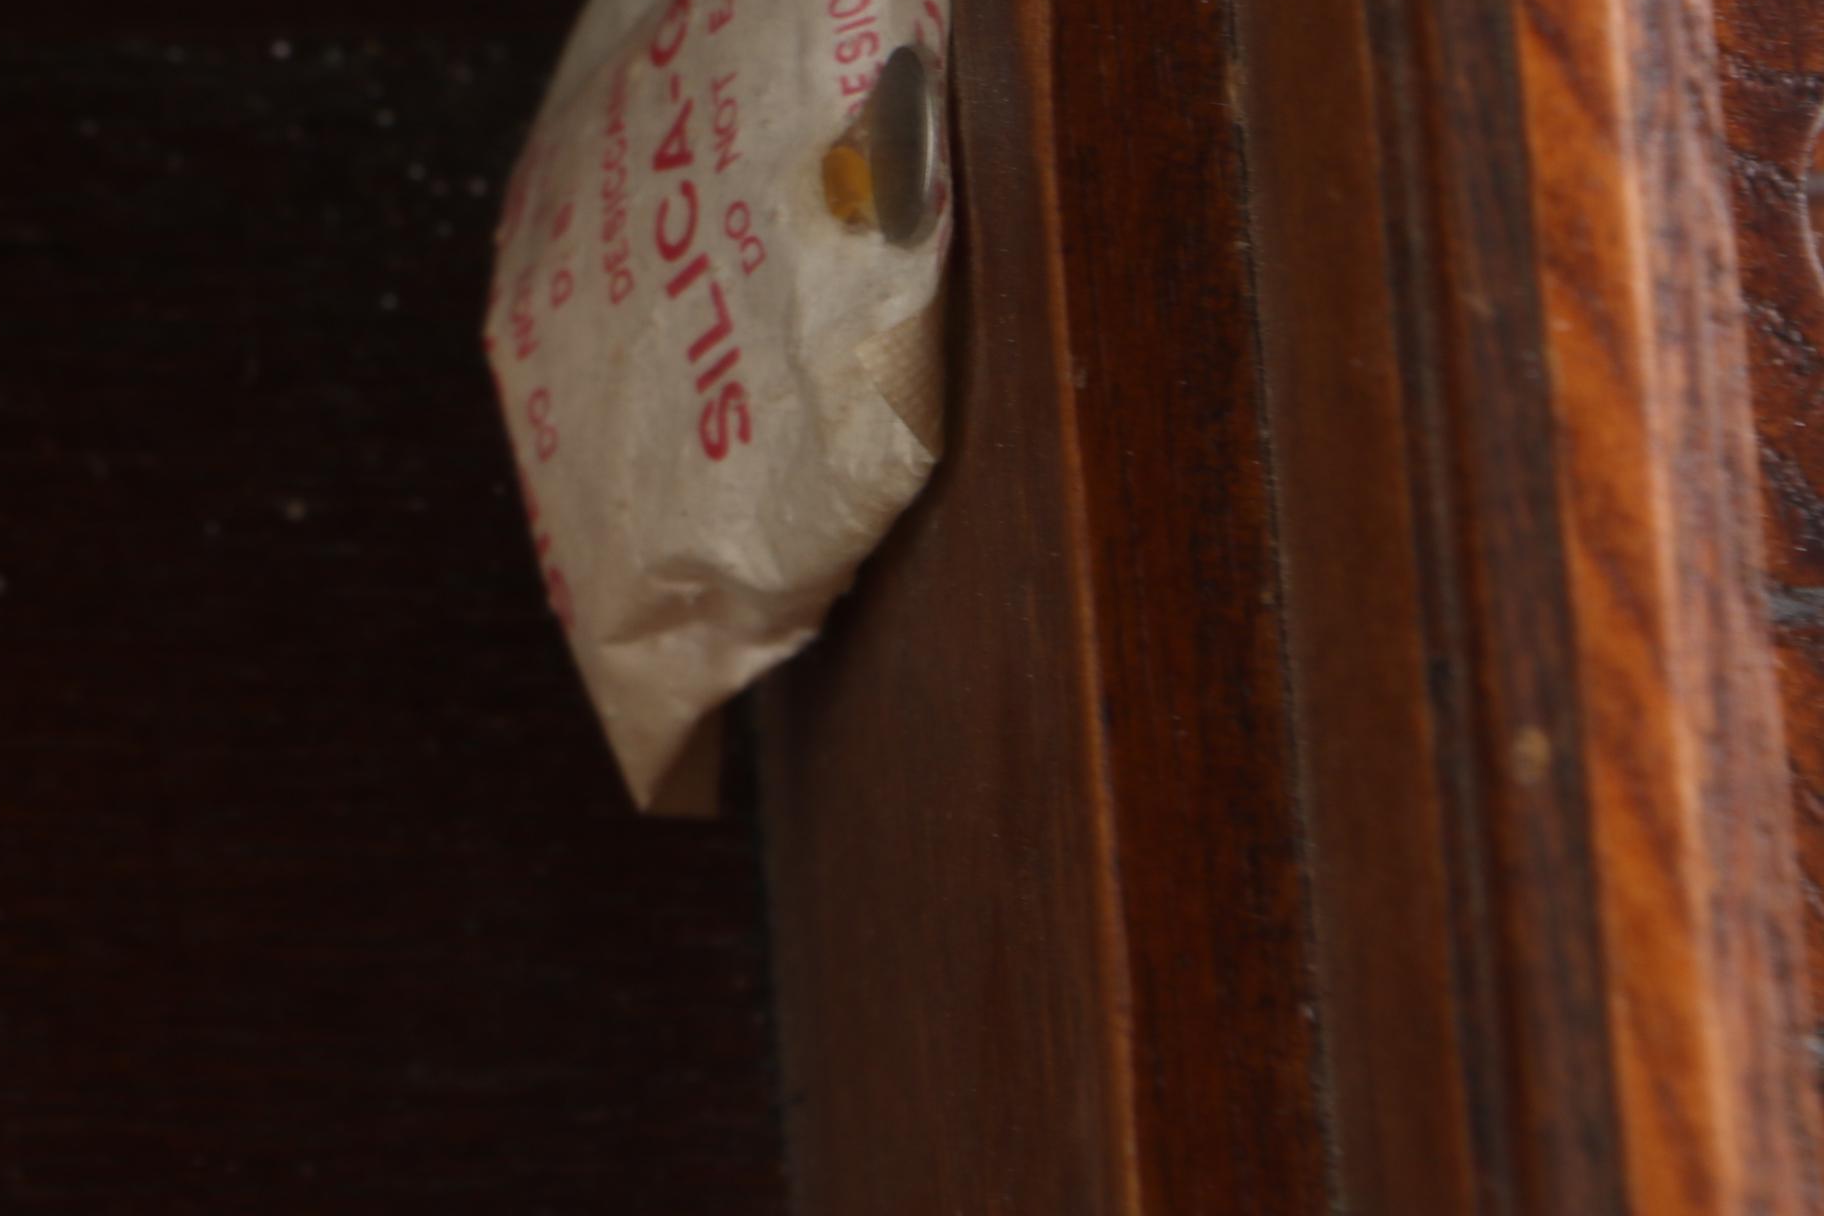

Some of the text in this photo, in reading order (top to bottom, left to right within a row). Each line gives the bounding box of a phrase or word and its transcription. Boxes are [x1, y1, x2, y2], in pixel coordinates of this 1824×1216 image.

[712, 72, 742, 173] NOT
[725, 200, 766, 275] DO
[526, 386, 559, 463] DO
